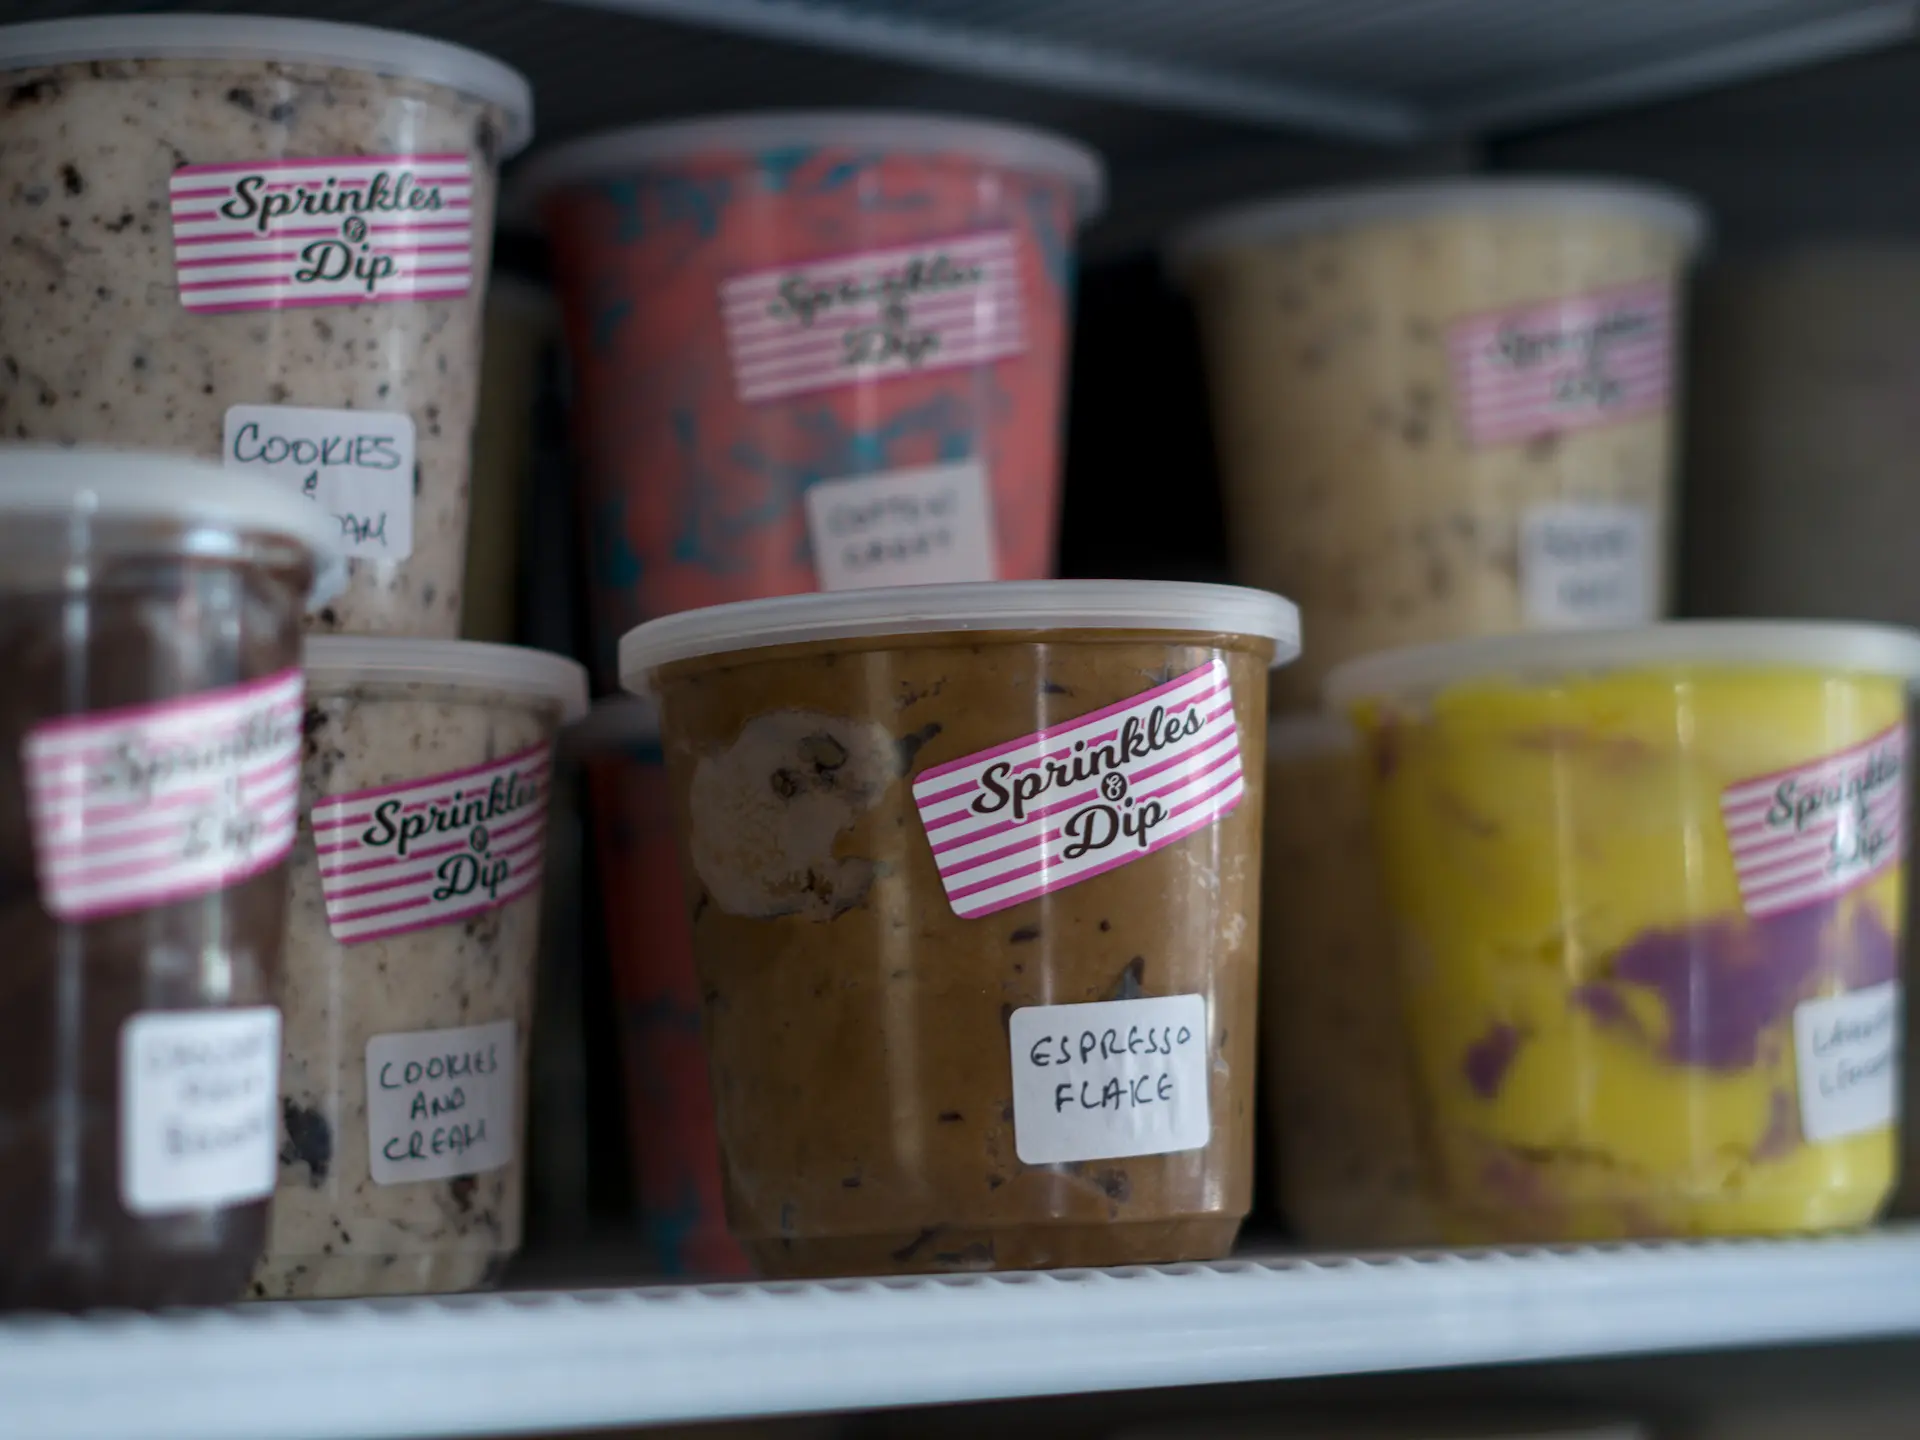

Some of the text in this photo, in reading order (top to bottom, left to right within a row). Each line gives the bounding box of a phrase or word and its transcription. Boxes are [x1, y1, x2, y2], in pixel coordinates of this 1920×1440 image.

[220, 171, 447, 231] Sprinkles
[295, 240, 399, 292] Dip
[234, 421, 402, 470] COOKIES
[971, 705, 1205, 819] Sprinkles
[1101, 771, 1128, 801] &
[1063, 796, 1168, 860] Dip
[432, 851, 509, 901] Dip
[379, 1042, 498, 1088] COOKIES
[1030, 1025, 1192, 1067] ESPRESSO
[410, 1086, 466, 1121] AND
[1054, 1072, 1173, 1113] FLAKE
[382, 1118, 487, 1161] CREAM
